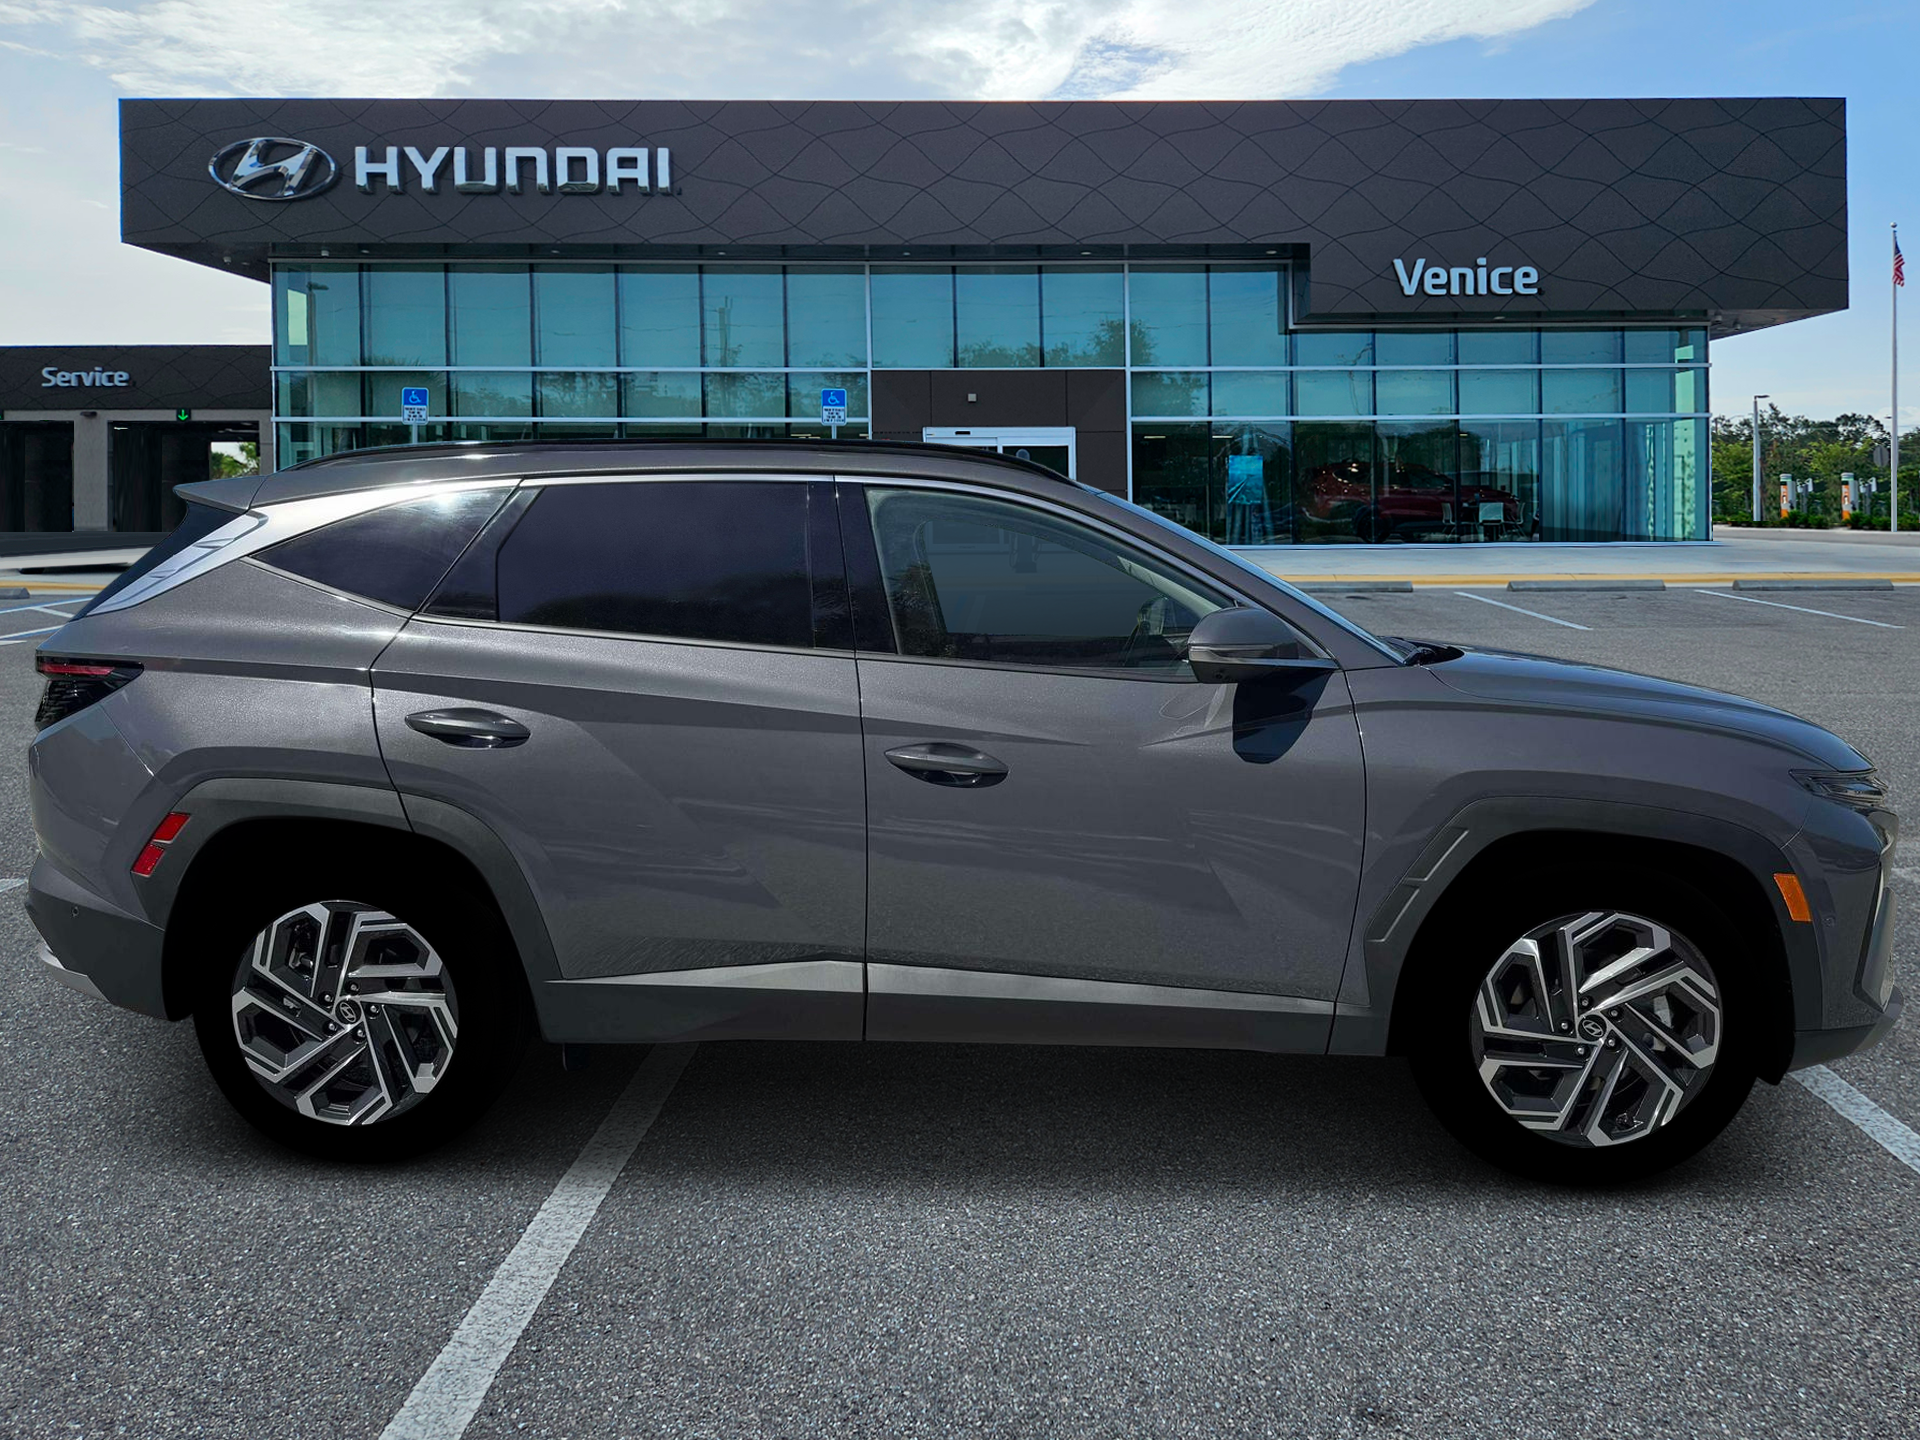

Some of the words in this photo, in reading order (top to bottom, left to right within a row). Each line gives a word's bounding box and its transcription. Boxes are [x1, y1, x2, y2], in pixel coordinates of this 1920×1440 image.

[354, 146, 672, 194] HYUNDAI
[1392, 257, 1539, 296] Venice
[41, 366, 130, 387] Service
